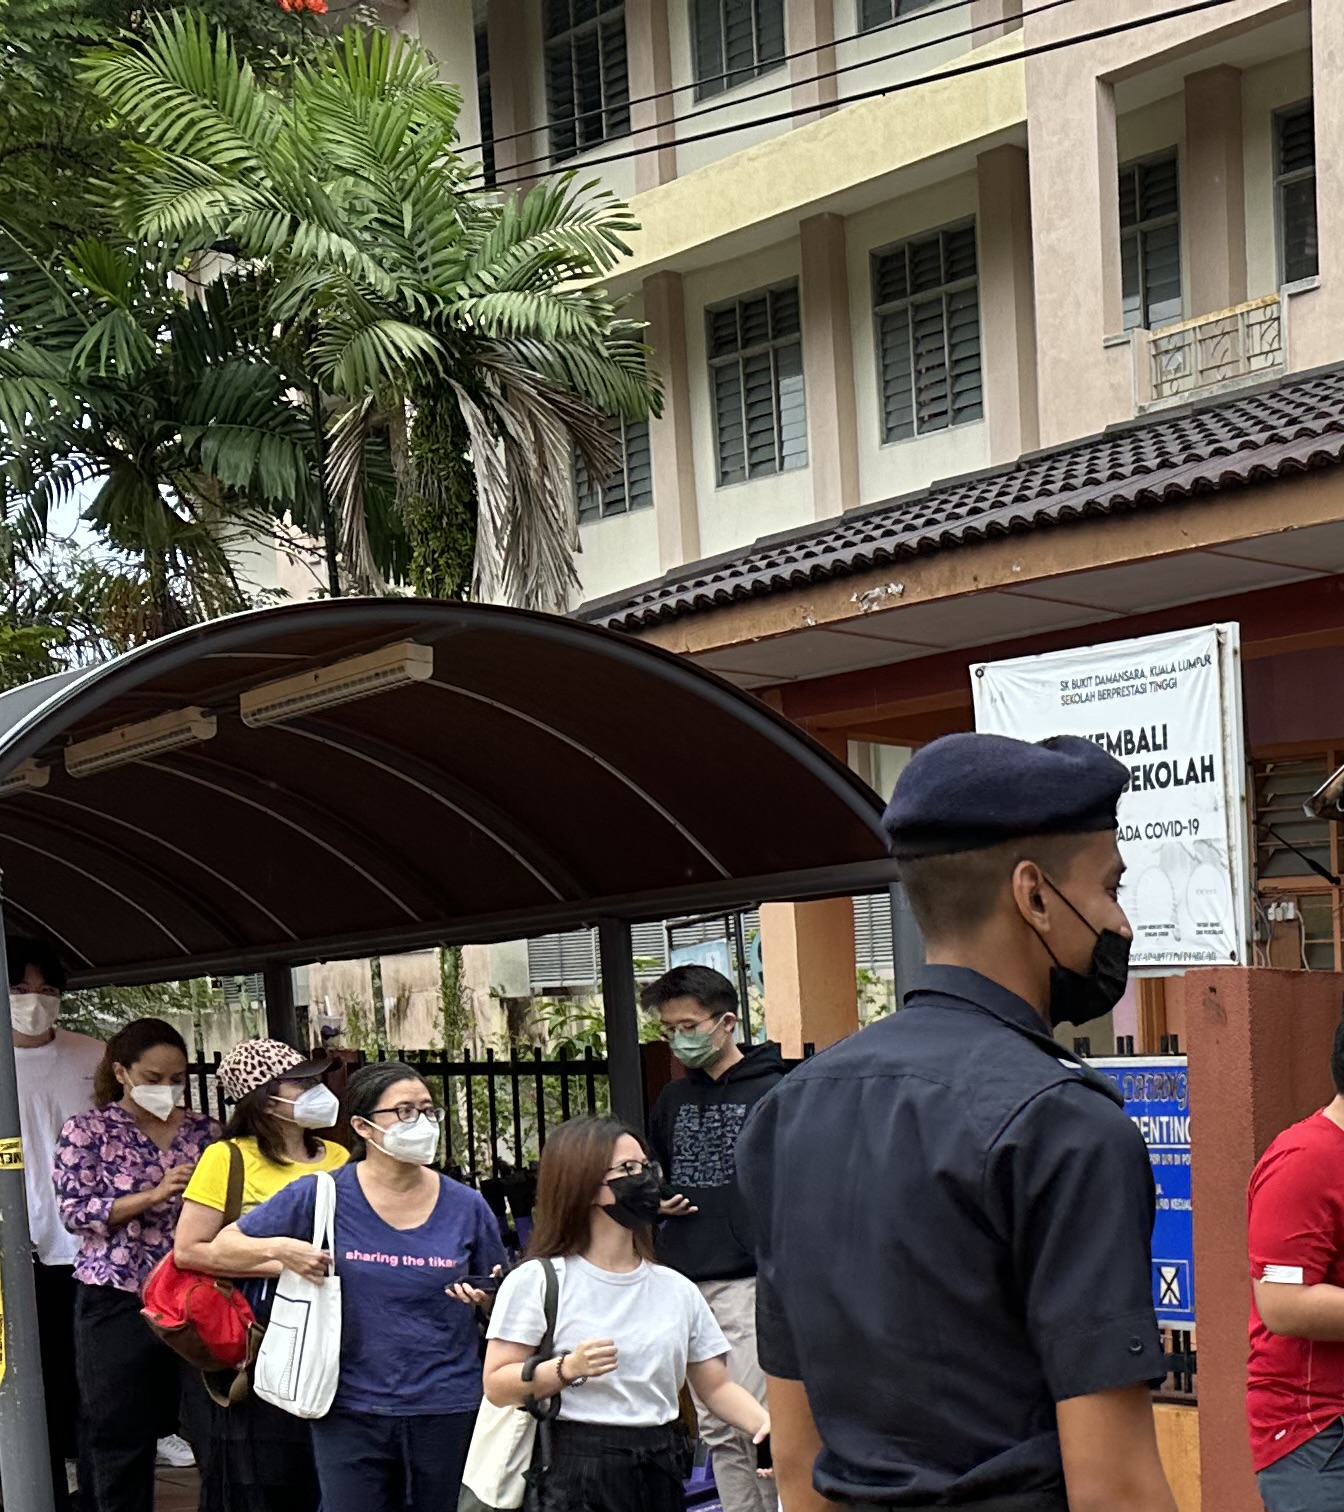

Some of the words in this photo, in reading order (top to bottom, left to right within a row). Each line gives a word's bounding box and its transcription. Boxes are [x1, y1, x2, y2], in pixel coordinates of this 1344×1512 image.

[1071, 676, 1093, 689] BUKIT
[1094, 668, 1148, 686] DAMANSARA,
[1150, 662, 1177, 677] KUALA
[1178, 654, 1212, 671] LUMPUR
[1061, 691, 1096, 706] SEKOLAH
[1097, 684, 1148, 701] BERPRESTASI
[1149, 677, 1178, 693] TINGGI
[1144, 818, 1200, 840] COVID-19
[345, 1250, 398, 1267] sharing
[402, 1255, 425, 1266] the
